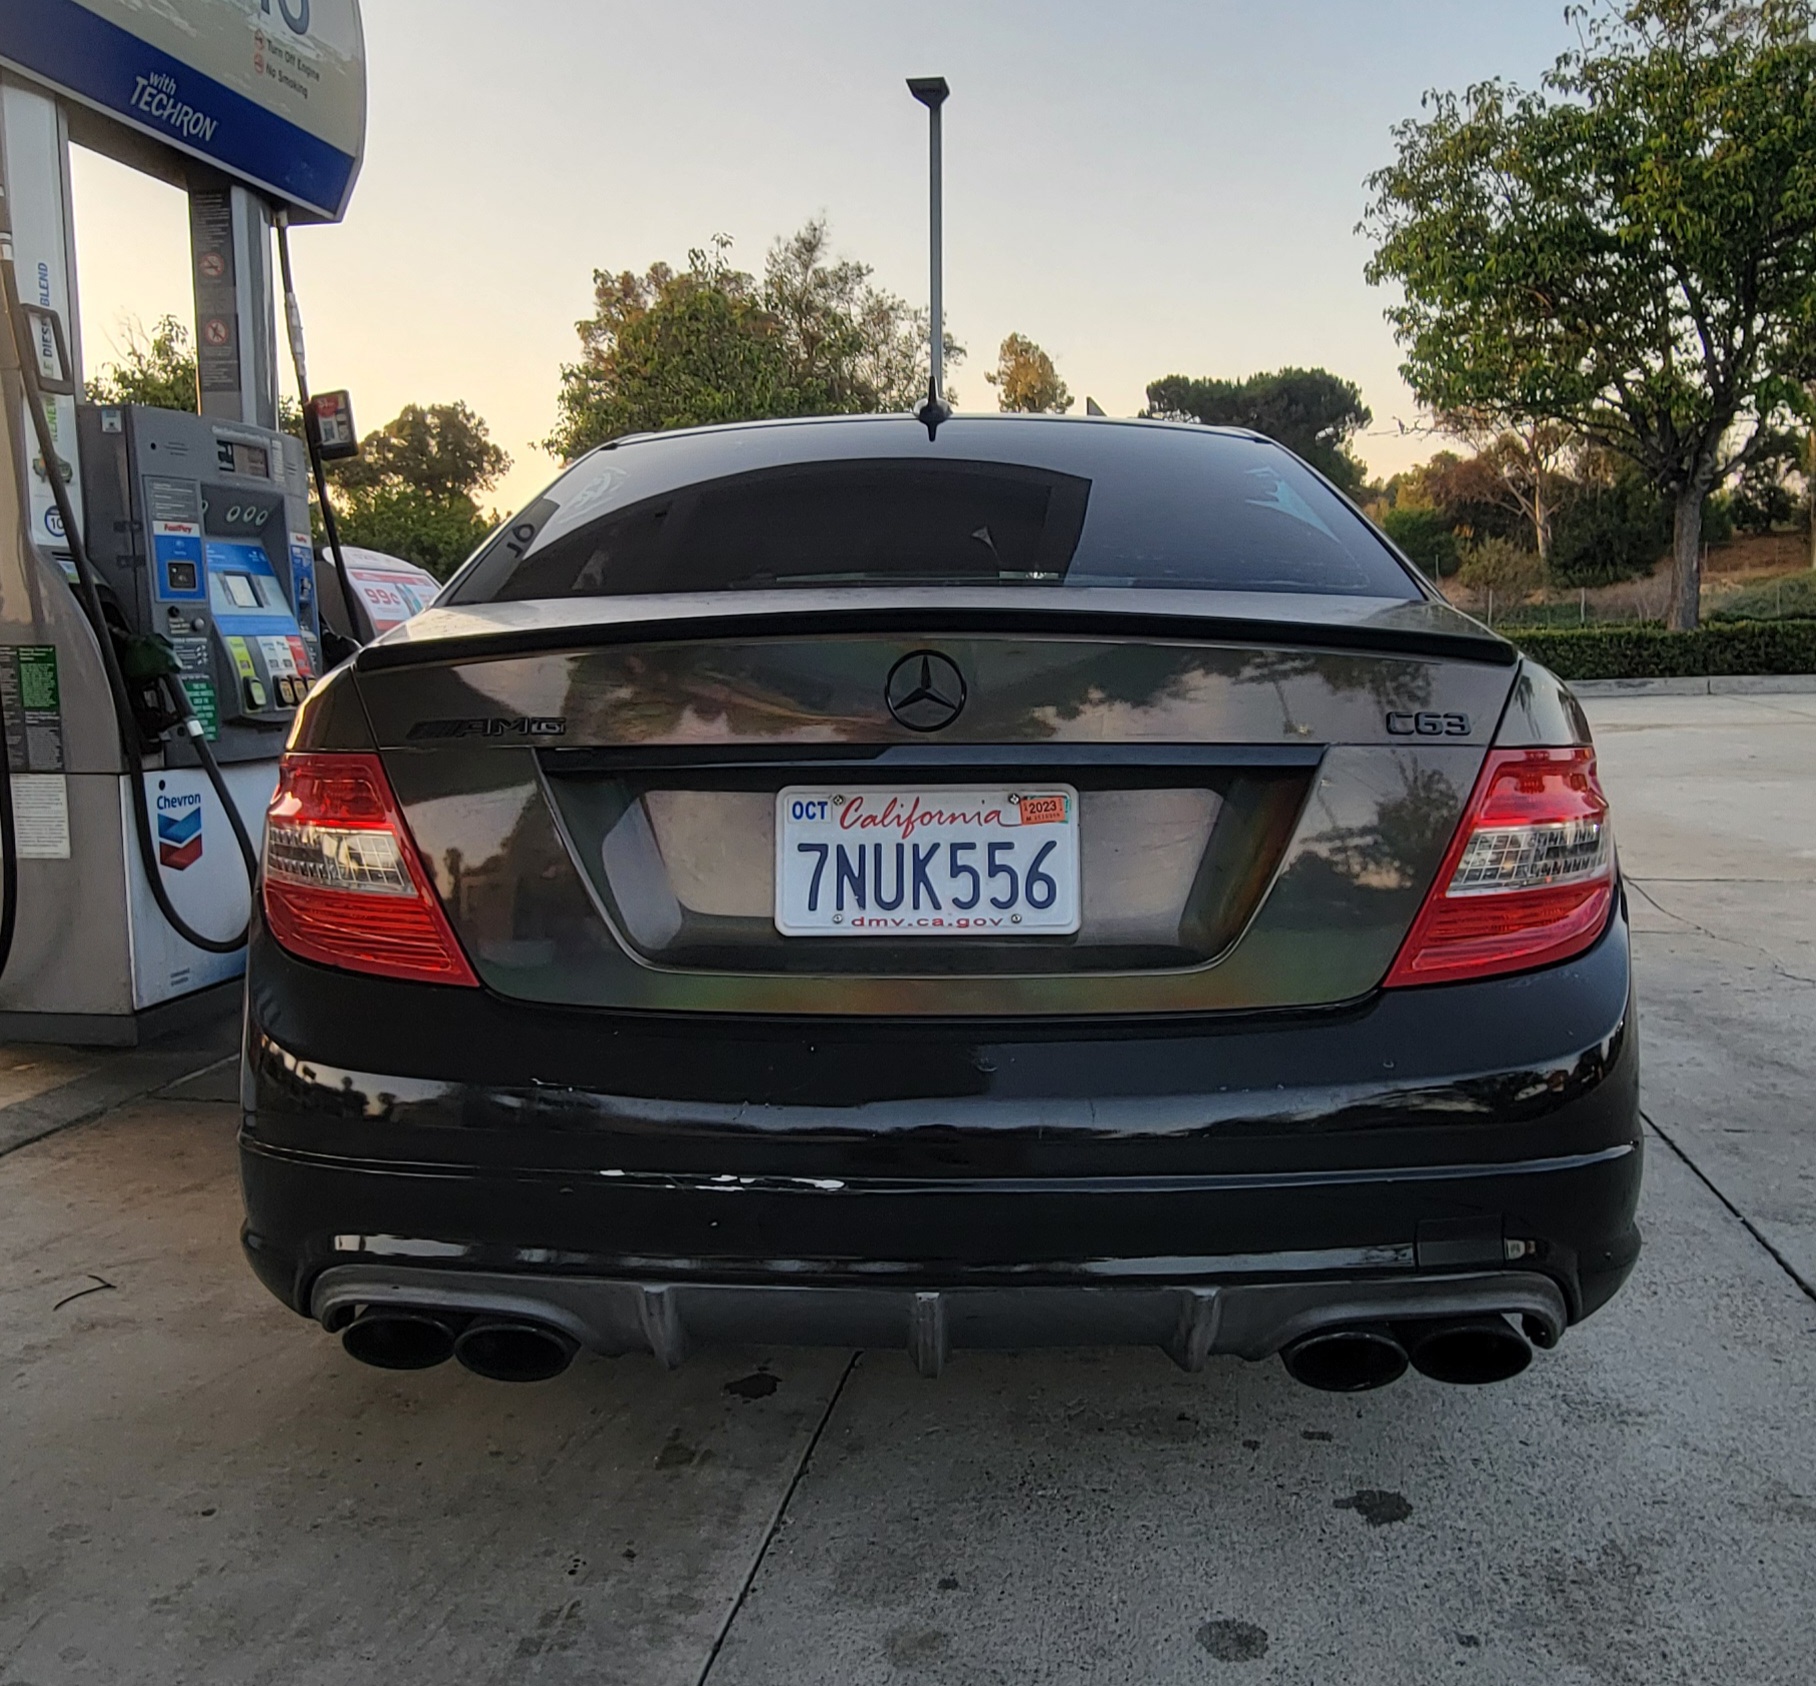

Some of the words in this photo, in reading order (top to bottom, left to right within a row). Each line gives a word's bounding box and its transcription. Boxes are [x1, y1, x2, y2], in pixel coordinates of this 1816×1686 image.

[266, 39, 284, 59] Turn
[284, 49, 296, 67] Off
[297, 58, 320, 82] Engine
[149, 71, 177, 96] with
[266, 63, 277, 79] No
[278, 69, 308, 99] Smoking
[129, 75, 217, 142] TECHRON
[38, 262, 50, 307] BLEND
[163, 523, 193, 535] FastPay
[456, 716, 566, 738] AMG
[1385, 711, 1472, 737] C63
[156, 792, 201, 810] Chevron
[791, 800, 829, 821] OCT
[1029, 800, 1057, 814] 2023
[839, 795, 1021, 840] California
[797, 840, 1058, 912] 7NUK556
[850, 916, 1004, 930] dmv.ca.gov
